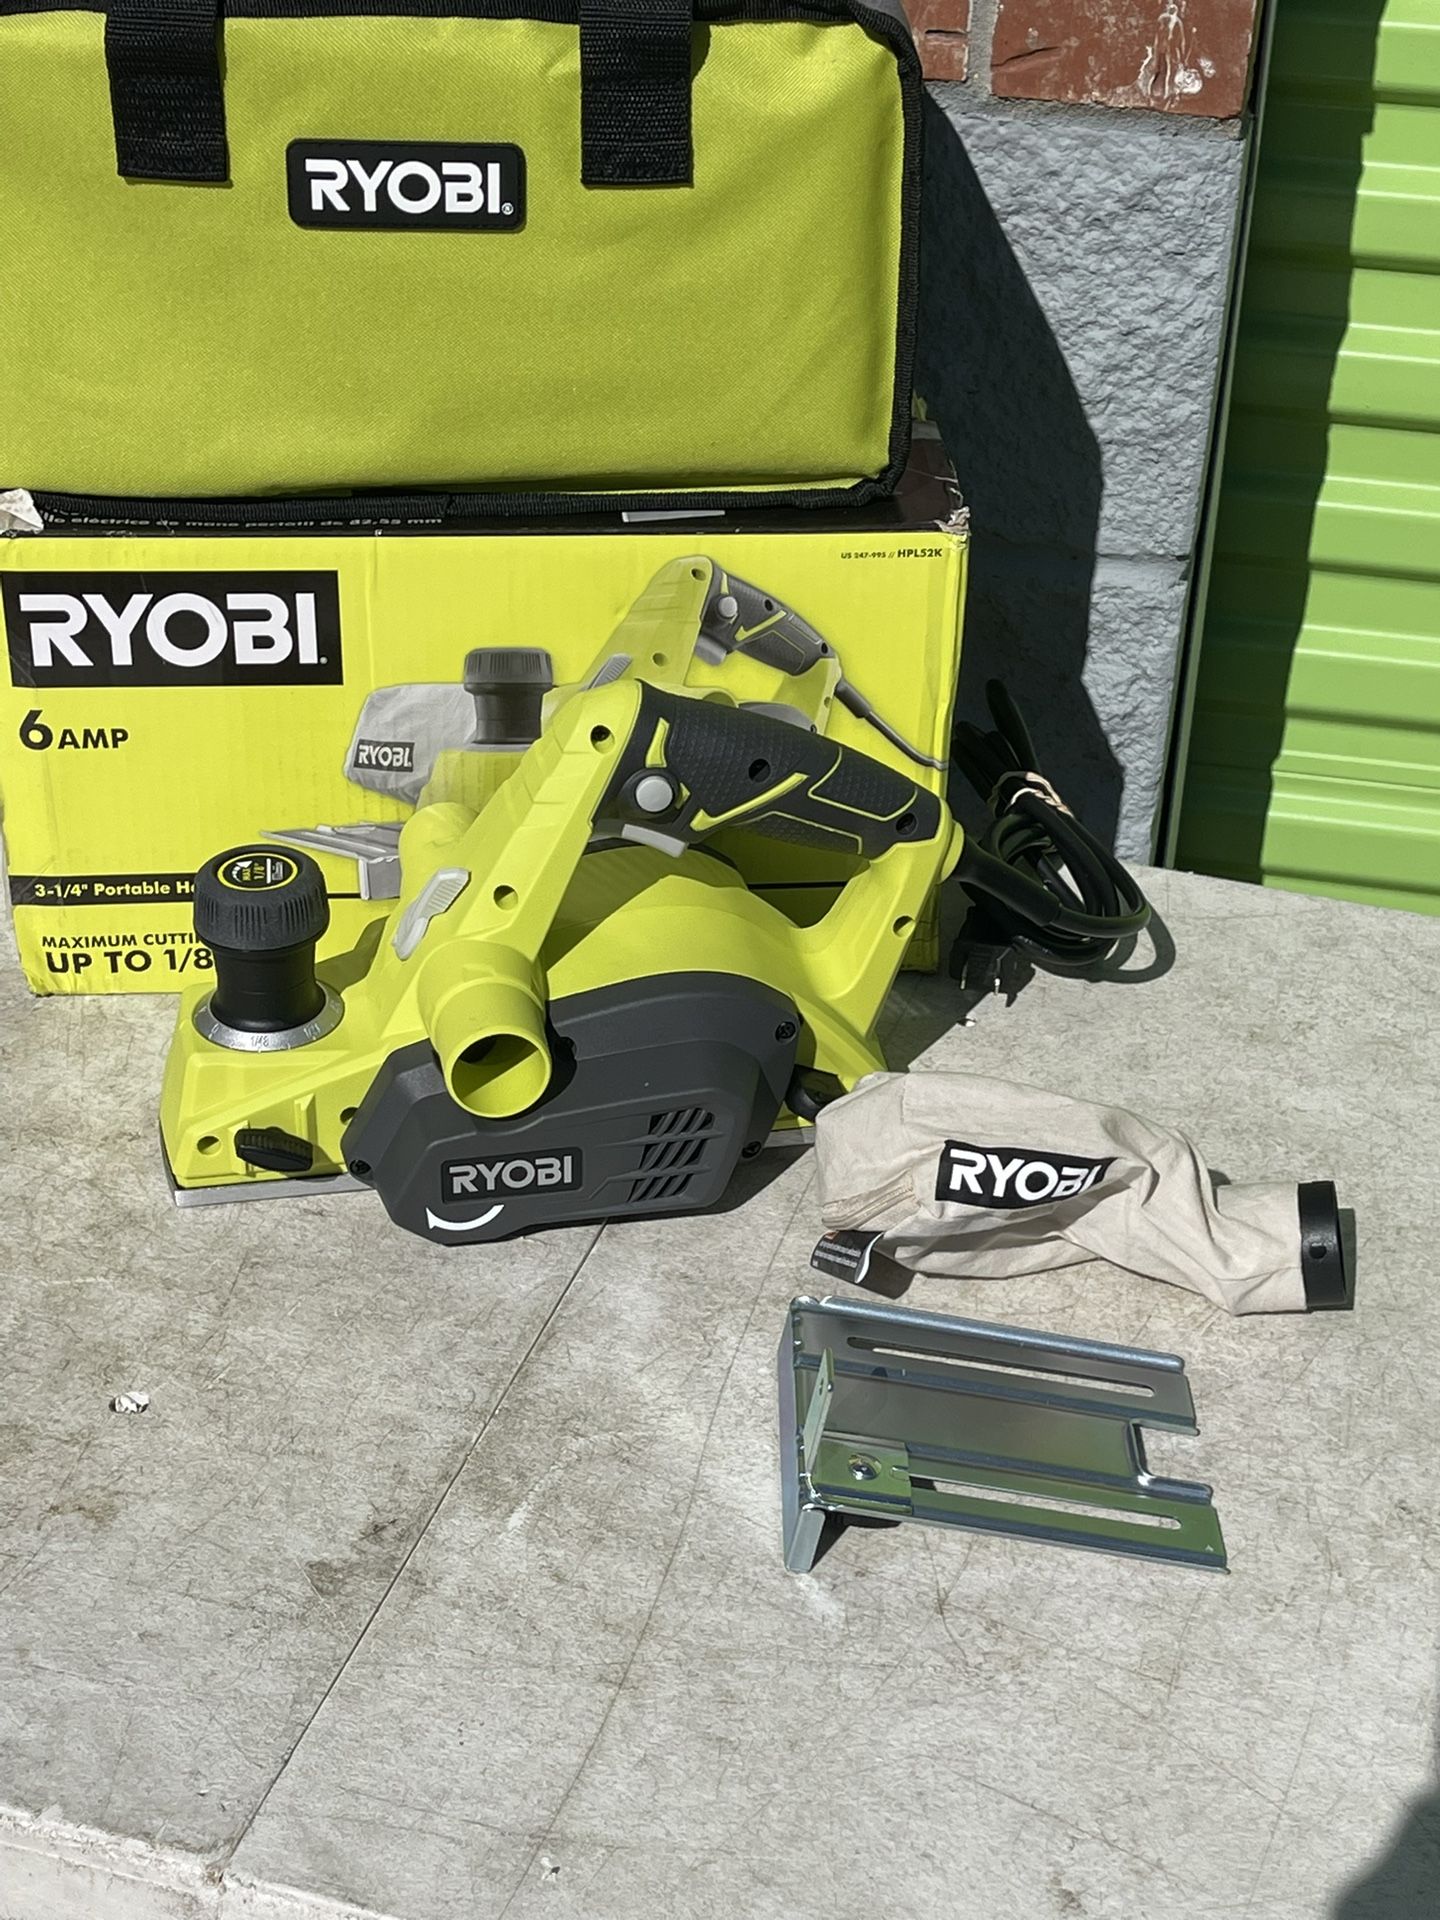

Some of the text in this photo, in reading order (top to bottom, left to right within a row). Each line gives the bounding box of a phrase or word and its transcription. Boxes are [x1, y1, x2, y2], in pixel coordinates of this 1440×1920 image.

[897, 548, 943, 558] HPL52K
[18, 592, 318, 667] RYOBI
[19, 709, 129, 751] 6 AMP
[358, 744, 410, 768] RYOBI
[93, 881, 171, 896] Portable
[42, 932, 200, 949] MAXIMUM CUTTI
[45, 951, 93, 975] UP
[103, 949, 152, 974] TO
[449, 1155, 573, 1194] RYOBI
[949, 1148, 1102, 1201] RYOBI
